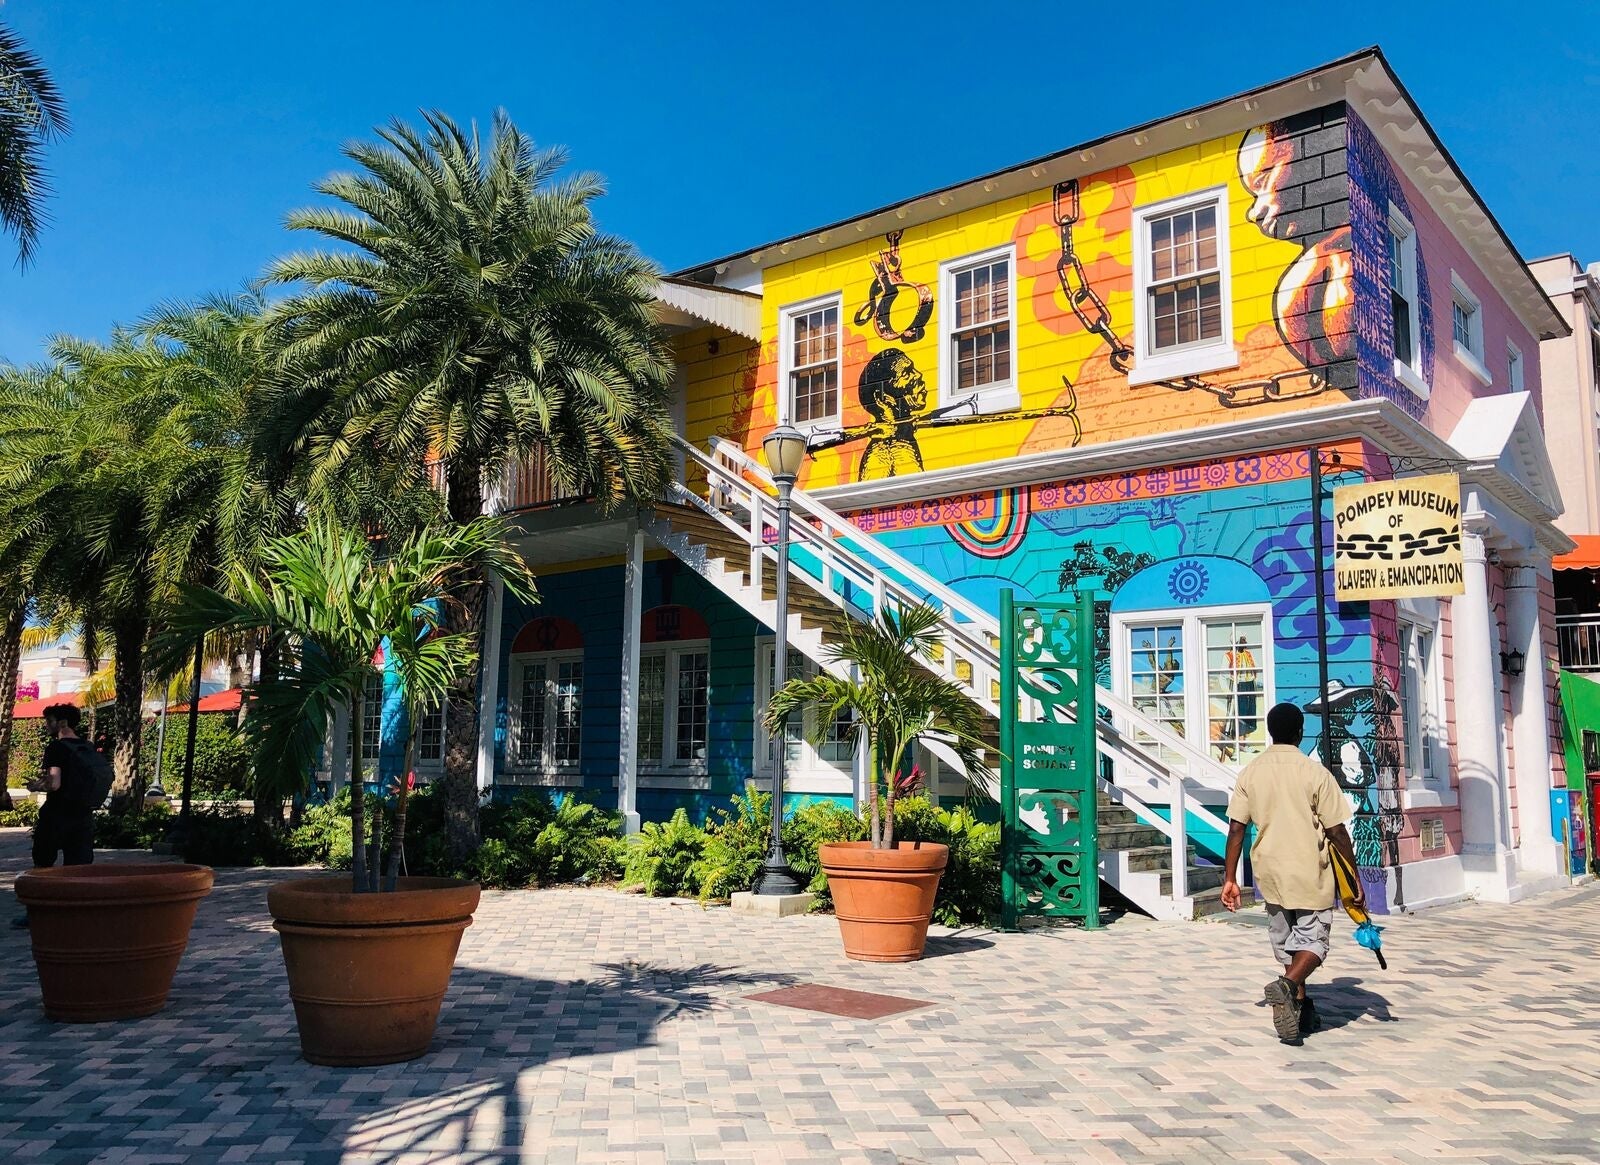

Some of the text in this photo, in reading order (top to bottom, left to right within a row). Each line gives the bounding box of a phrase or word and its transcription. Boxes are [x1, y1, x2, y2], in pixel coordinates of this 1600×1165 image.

[1336, 489, 1459, 529] POMPEY MUSEUM
[1388, 514, 1403, 528] OF
[1338, 562, 1463, 591] SLAVERY & EMANCIPATION
